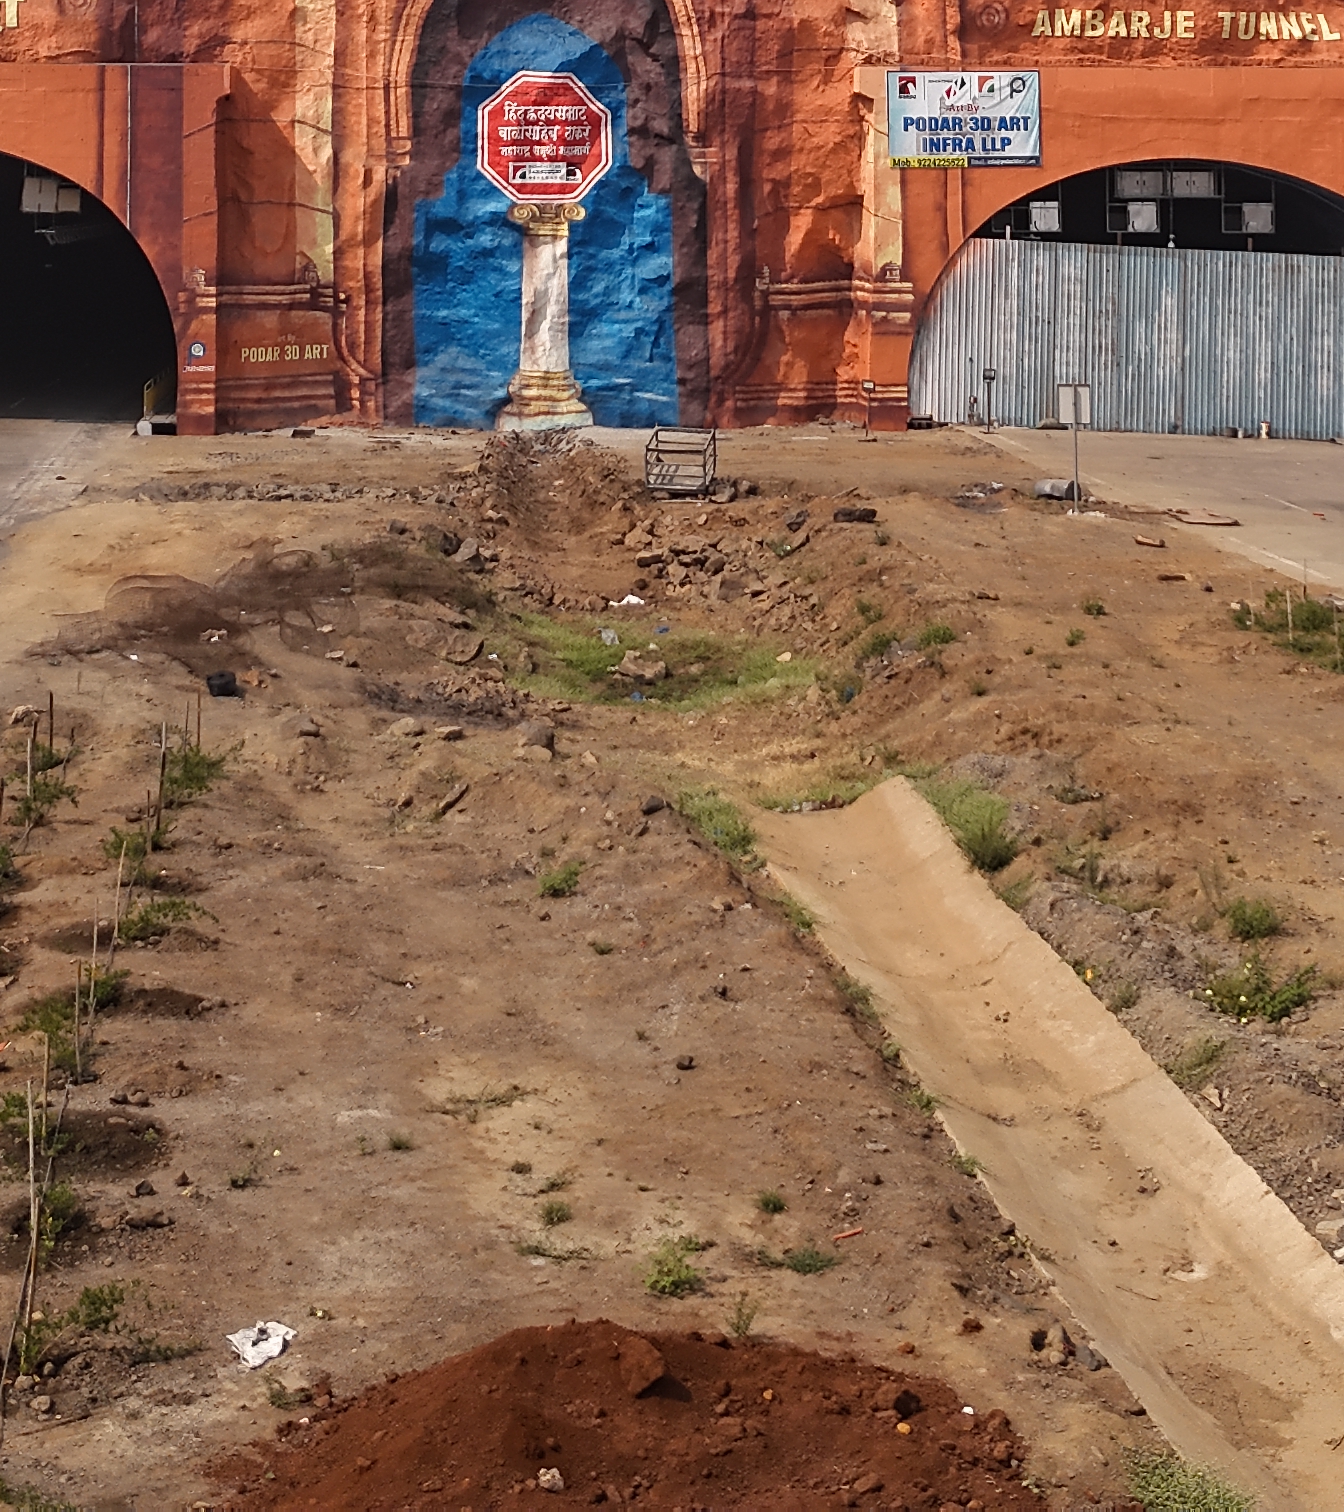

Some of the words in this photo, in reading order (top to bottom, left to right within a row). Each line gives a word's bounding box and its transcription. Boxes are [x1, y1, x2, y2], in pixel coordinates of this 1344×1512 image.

[1030, 8, 1196, 40] AMBARJE
[1218, 10, 1342, 42] TUNNEL
[902, 116, 963, 132] PODAR
[969, 116, 992, 132] 3D
[997, 116, 1031, 132] ART
[922, 137, 976, 153] INFRA
[981, 137, 1012, 152] LLP
[241, 346, 280, 363] PODAR
[284, 345, 300, 361] 3D
[304, 344, 330, 360] ART
